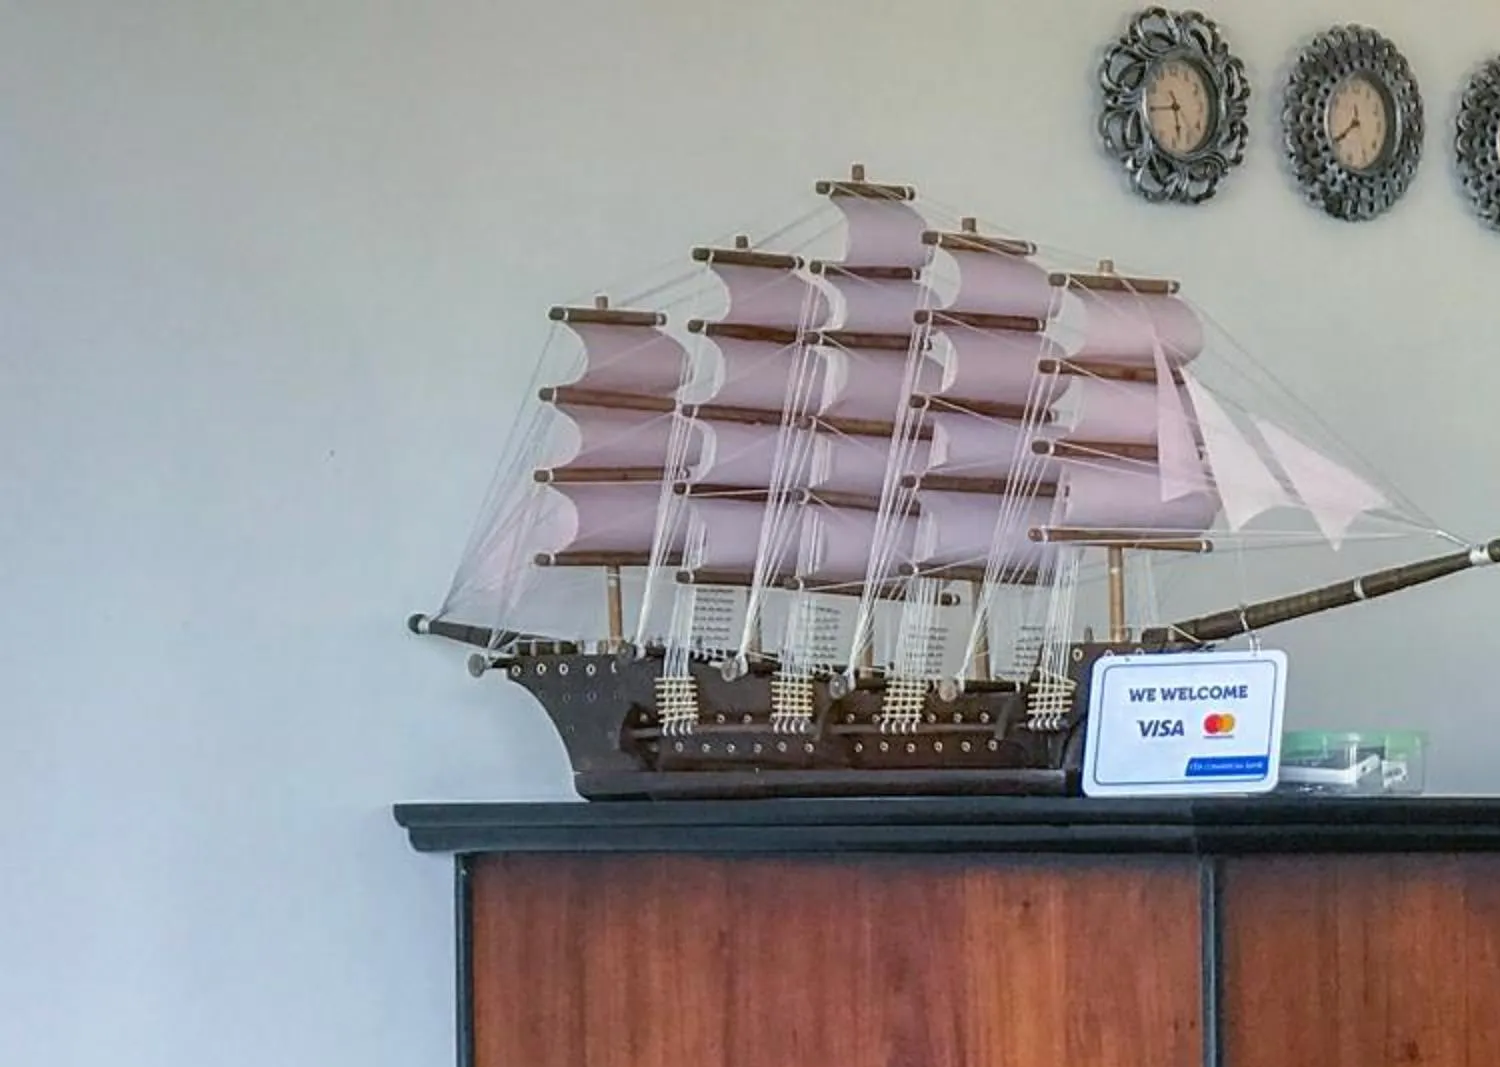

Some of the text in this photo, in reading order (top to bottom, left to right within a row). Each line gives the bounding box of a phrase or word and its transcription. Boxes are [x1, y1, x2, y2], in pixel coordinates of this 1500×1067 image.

[1129, 685, 1248, 702] WE WELCOME
[1137, 719, 1185, 738] VISA
